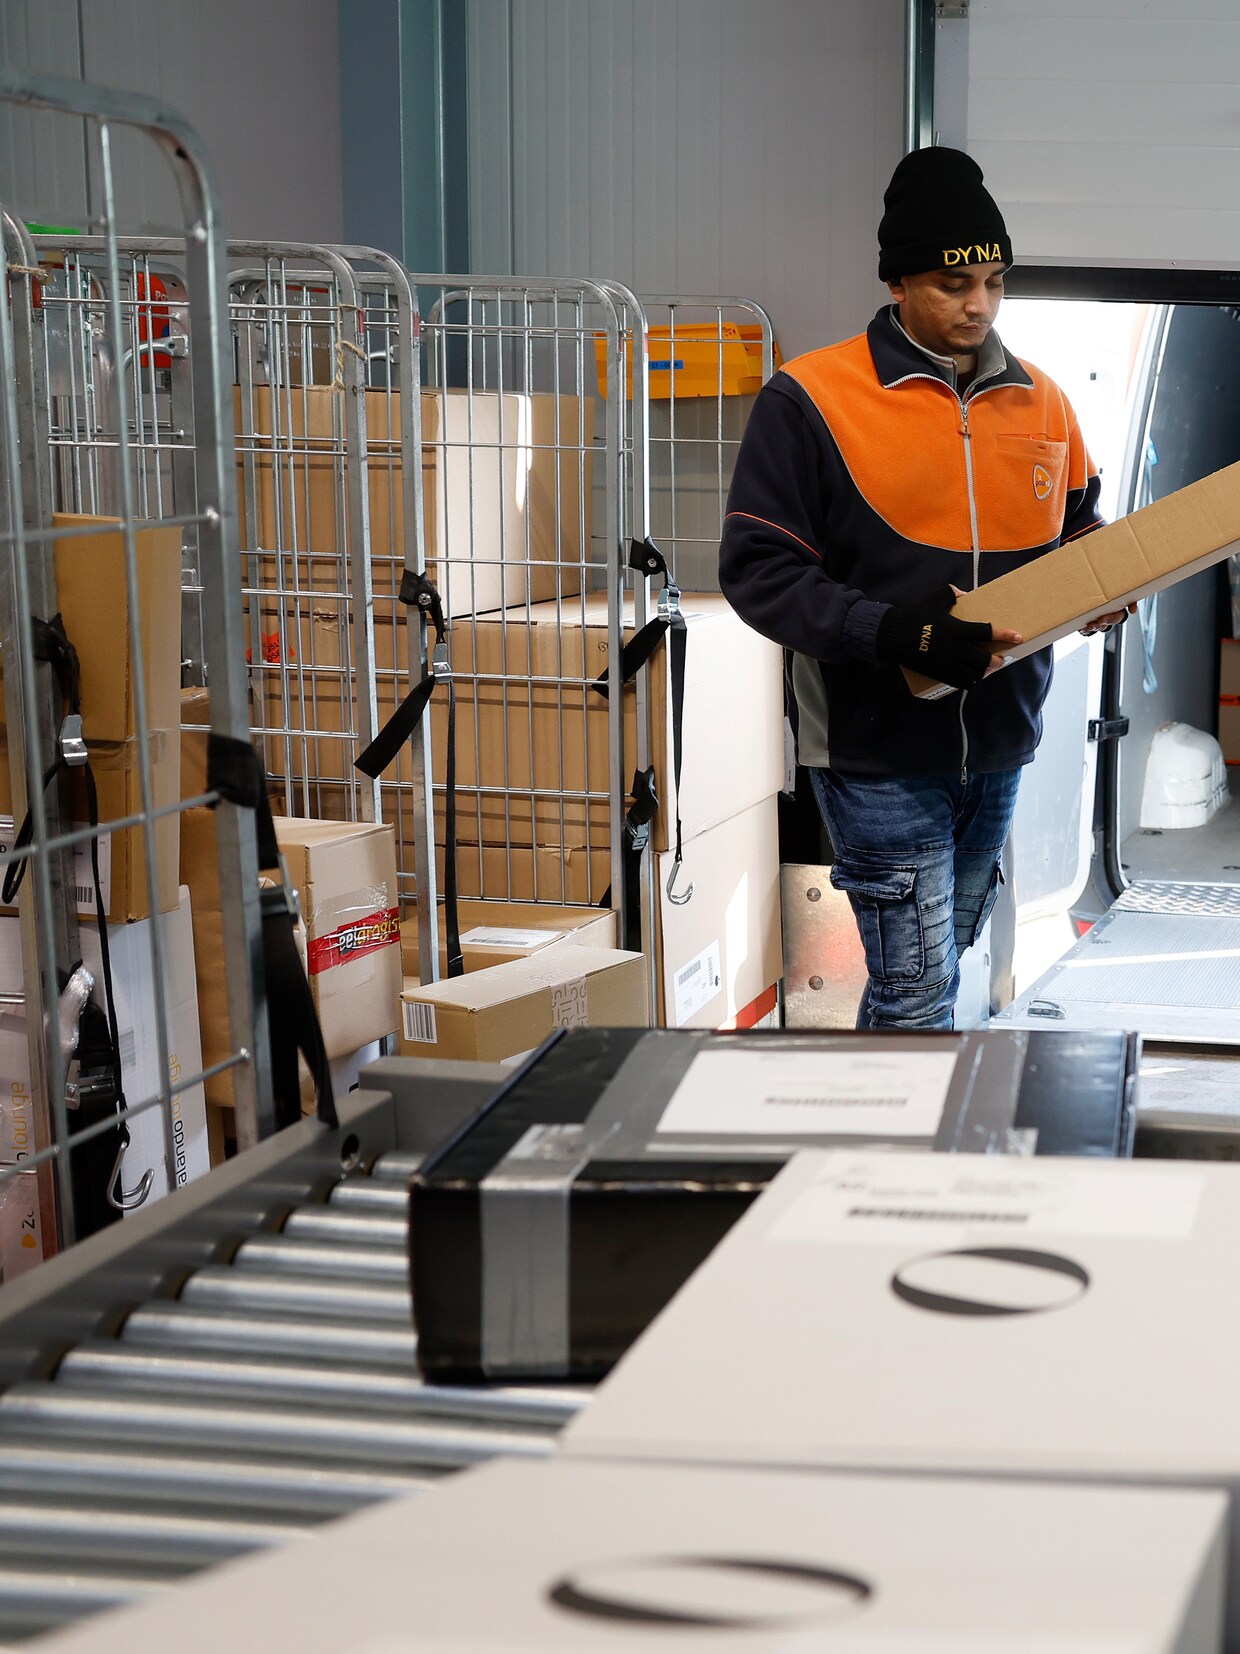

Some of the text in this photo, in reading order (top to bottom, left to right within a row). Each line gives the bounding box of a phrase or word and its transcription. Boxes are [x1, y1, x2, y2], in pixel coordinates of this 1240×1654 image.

[942, 243, 1002, 266] DYNA
[919, 624, 933, 652] DYNA
[173, 1120, 188, 1188] alando
